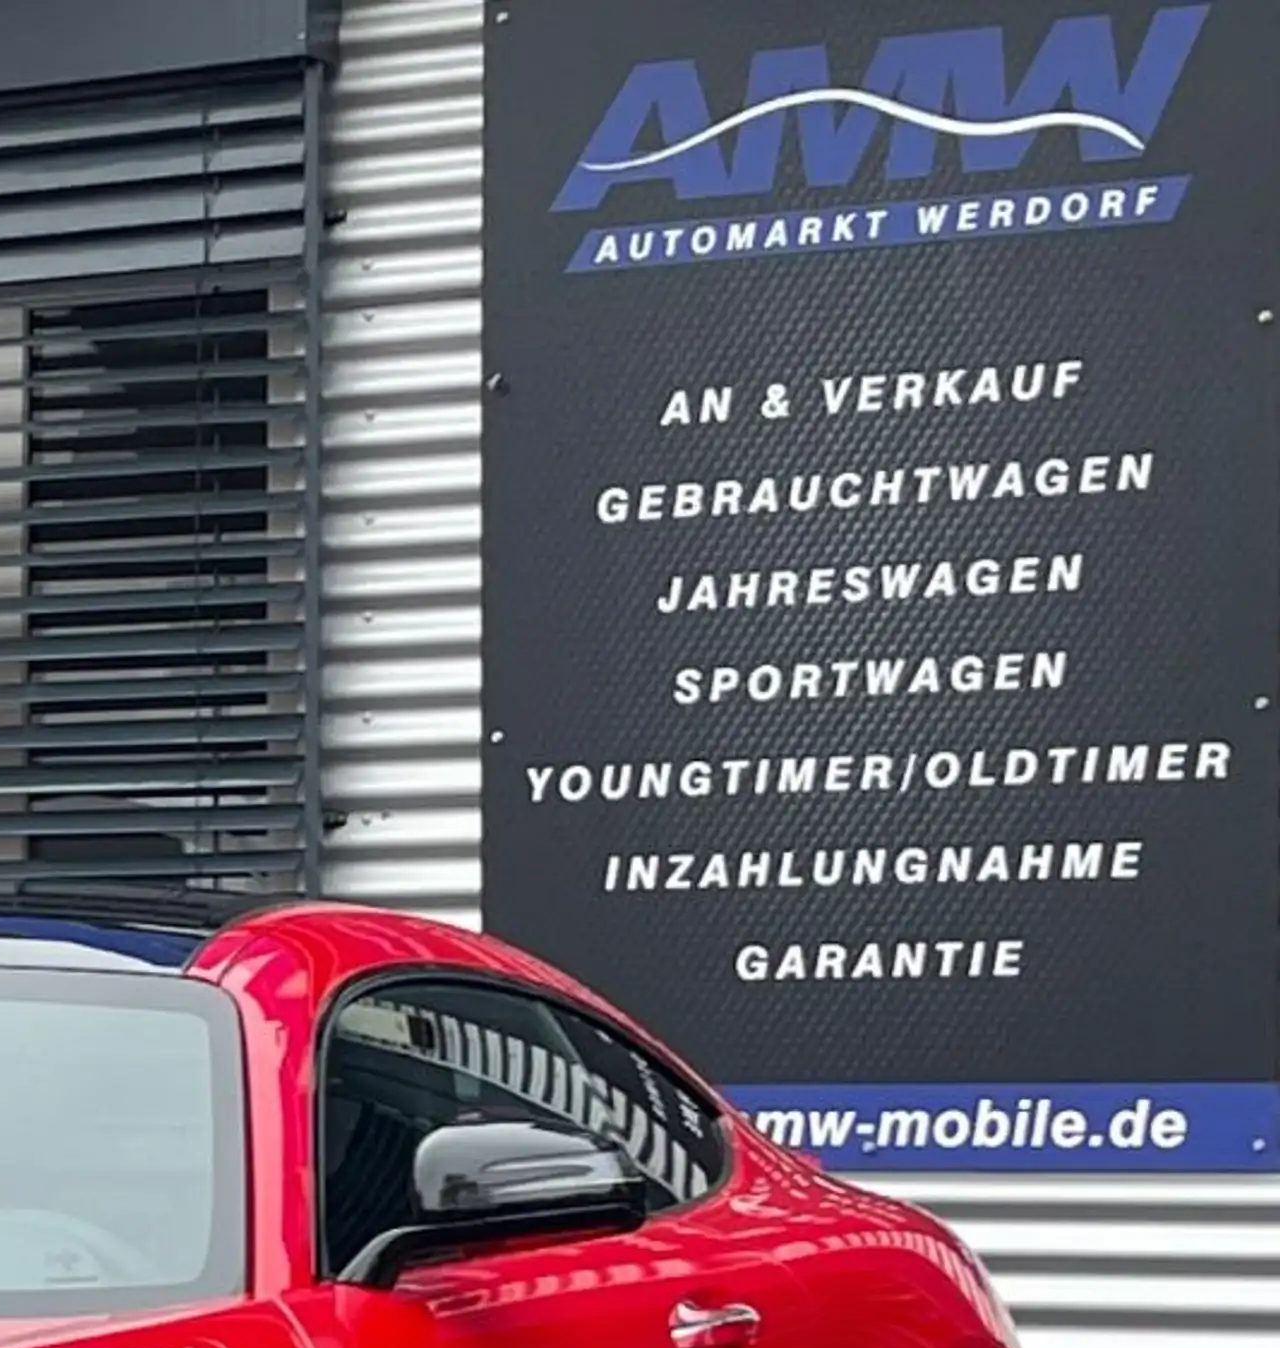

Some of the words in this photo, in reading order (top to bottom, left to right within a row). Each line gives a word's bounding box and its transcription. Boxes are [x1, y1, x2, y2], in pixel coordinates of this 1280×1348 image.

[548, 3, 1211, 212] AMW
[594, 210, 888, 264] AUTOMARKT
[917, 185, 1159, 234] WERDORF
[660, 386, 733, 426] AN
[760, 383, 791, 420] &
[822, 360, 1084, 415] VERKAUF
[597, 453, 1154, 524] GEBRAUCHTWAGEN
[656, 553, 1084, 612] JAHRESWAGEN
[673, 651, 1067, 704] SPORTWAGEN
[527, 742, 1230, 802] YOUNGTIMER/OLDTIMER
[604, 842, 1143, 891] INZAHLUNGNAHME
[735, 940, 1024, 981] GARANTIE
[740, 1098, 1188, 1148] mw-mobile.de
